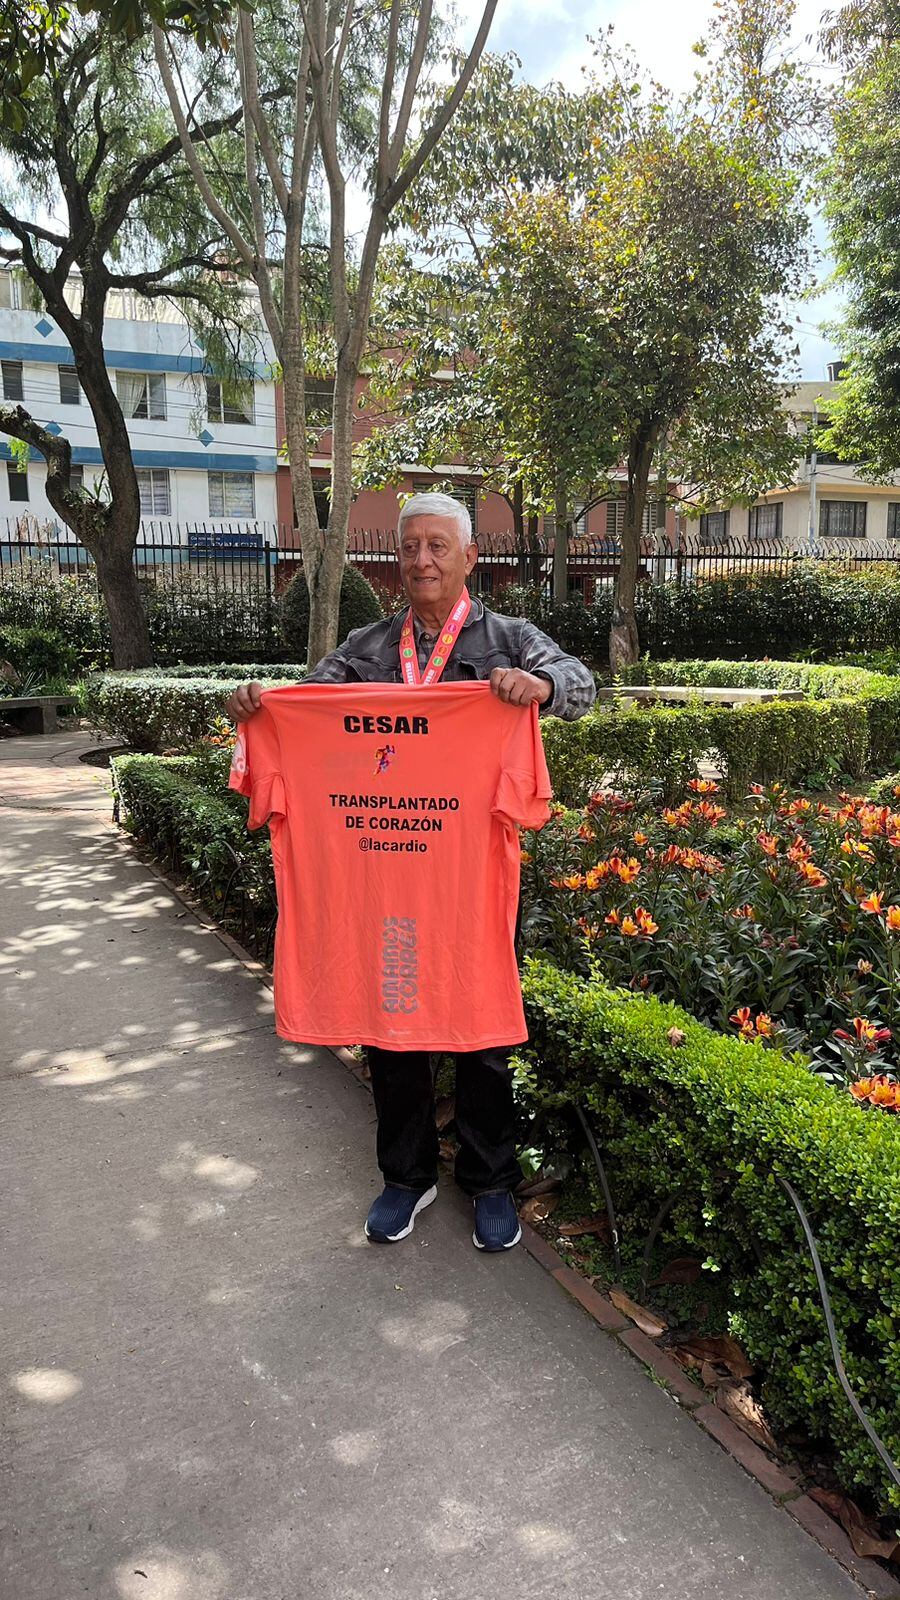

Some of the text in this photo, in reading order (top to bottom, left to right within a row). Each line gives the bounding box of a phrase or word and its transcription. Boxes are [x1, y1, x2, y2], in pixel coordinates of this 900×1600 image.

[344, 715, 429, 735] CESAR
[329, 794, 460, 811] TRANSPLANTADO
[345, 816, 443, 832] DE CORAZÓN
[358, 837, 428, 853] @lacardio
